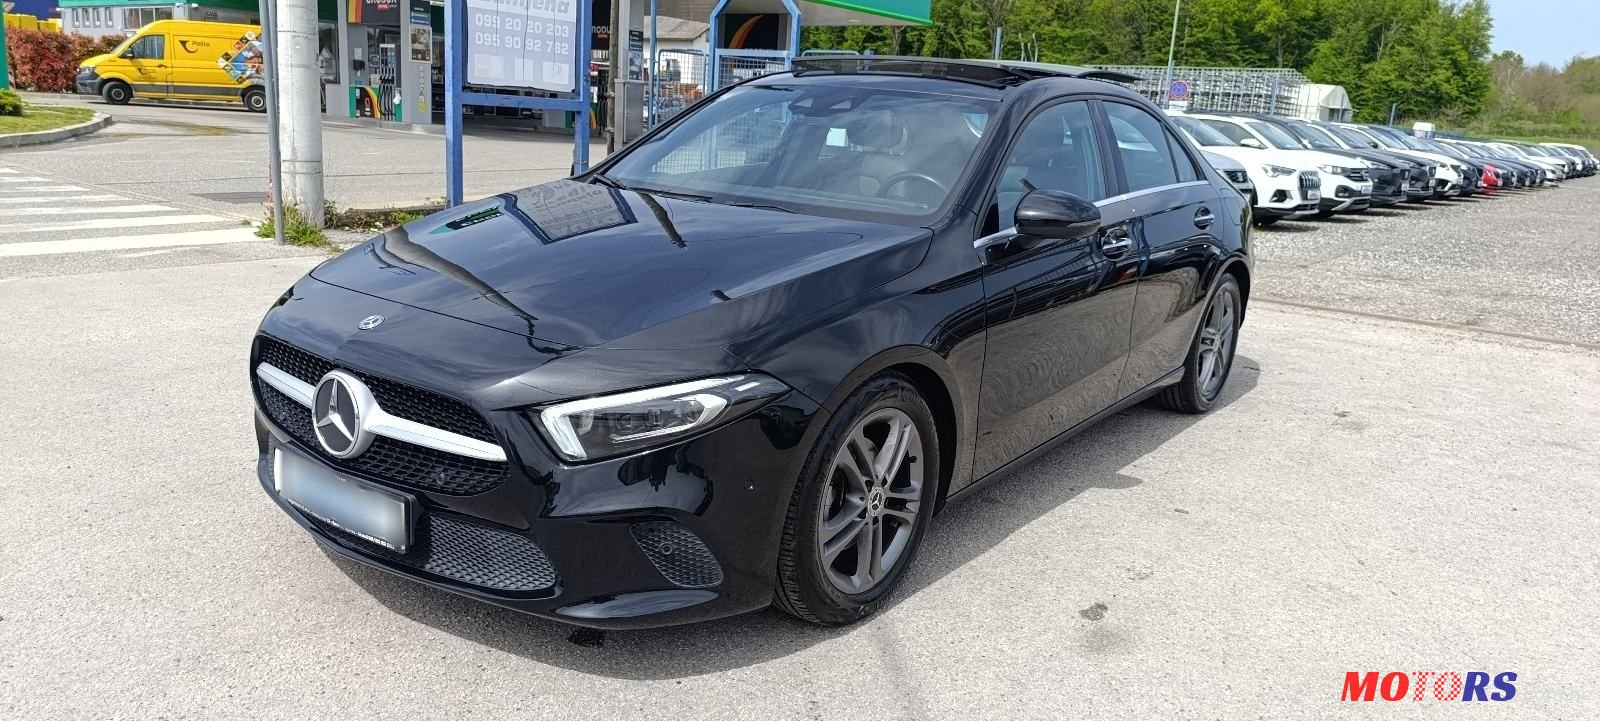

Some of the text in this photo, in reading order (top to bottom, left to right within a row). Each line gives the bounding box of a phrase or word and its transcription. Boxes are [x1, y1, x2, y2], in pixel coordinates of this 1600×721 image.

[475, 13, 569, 38] 099 20 20 203
[475, 31, 569, 55] 095 90 92 782
